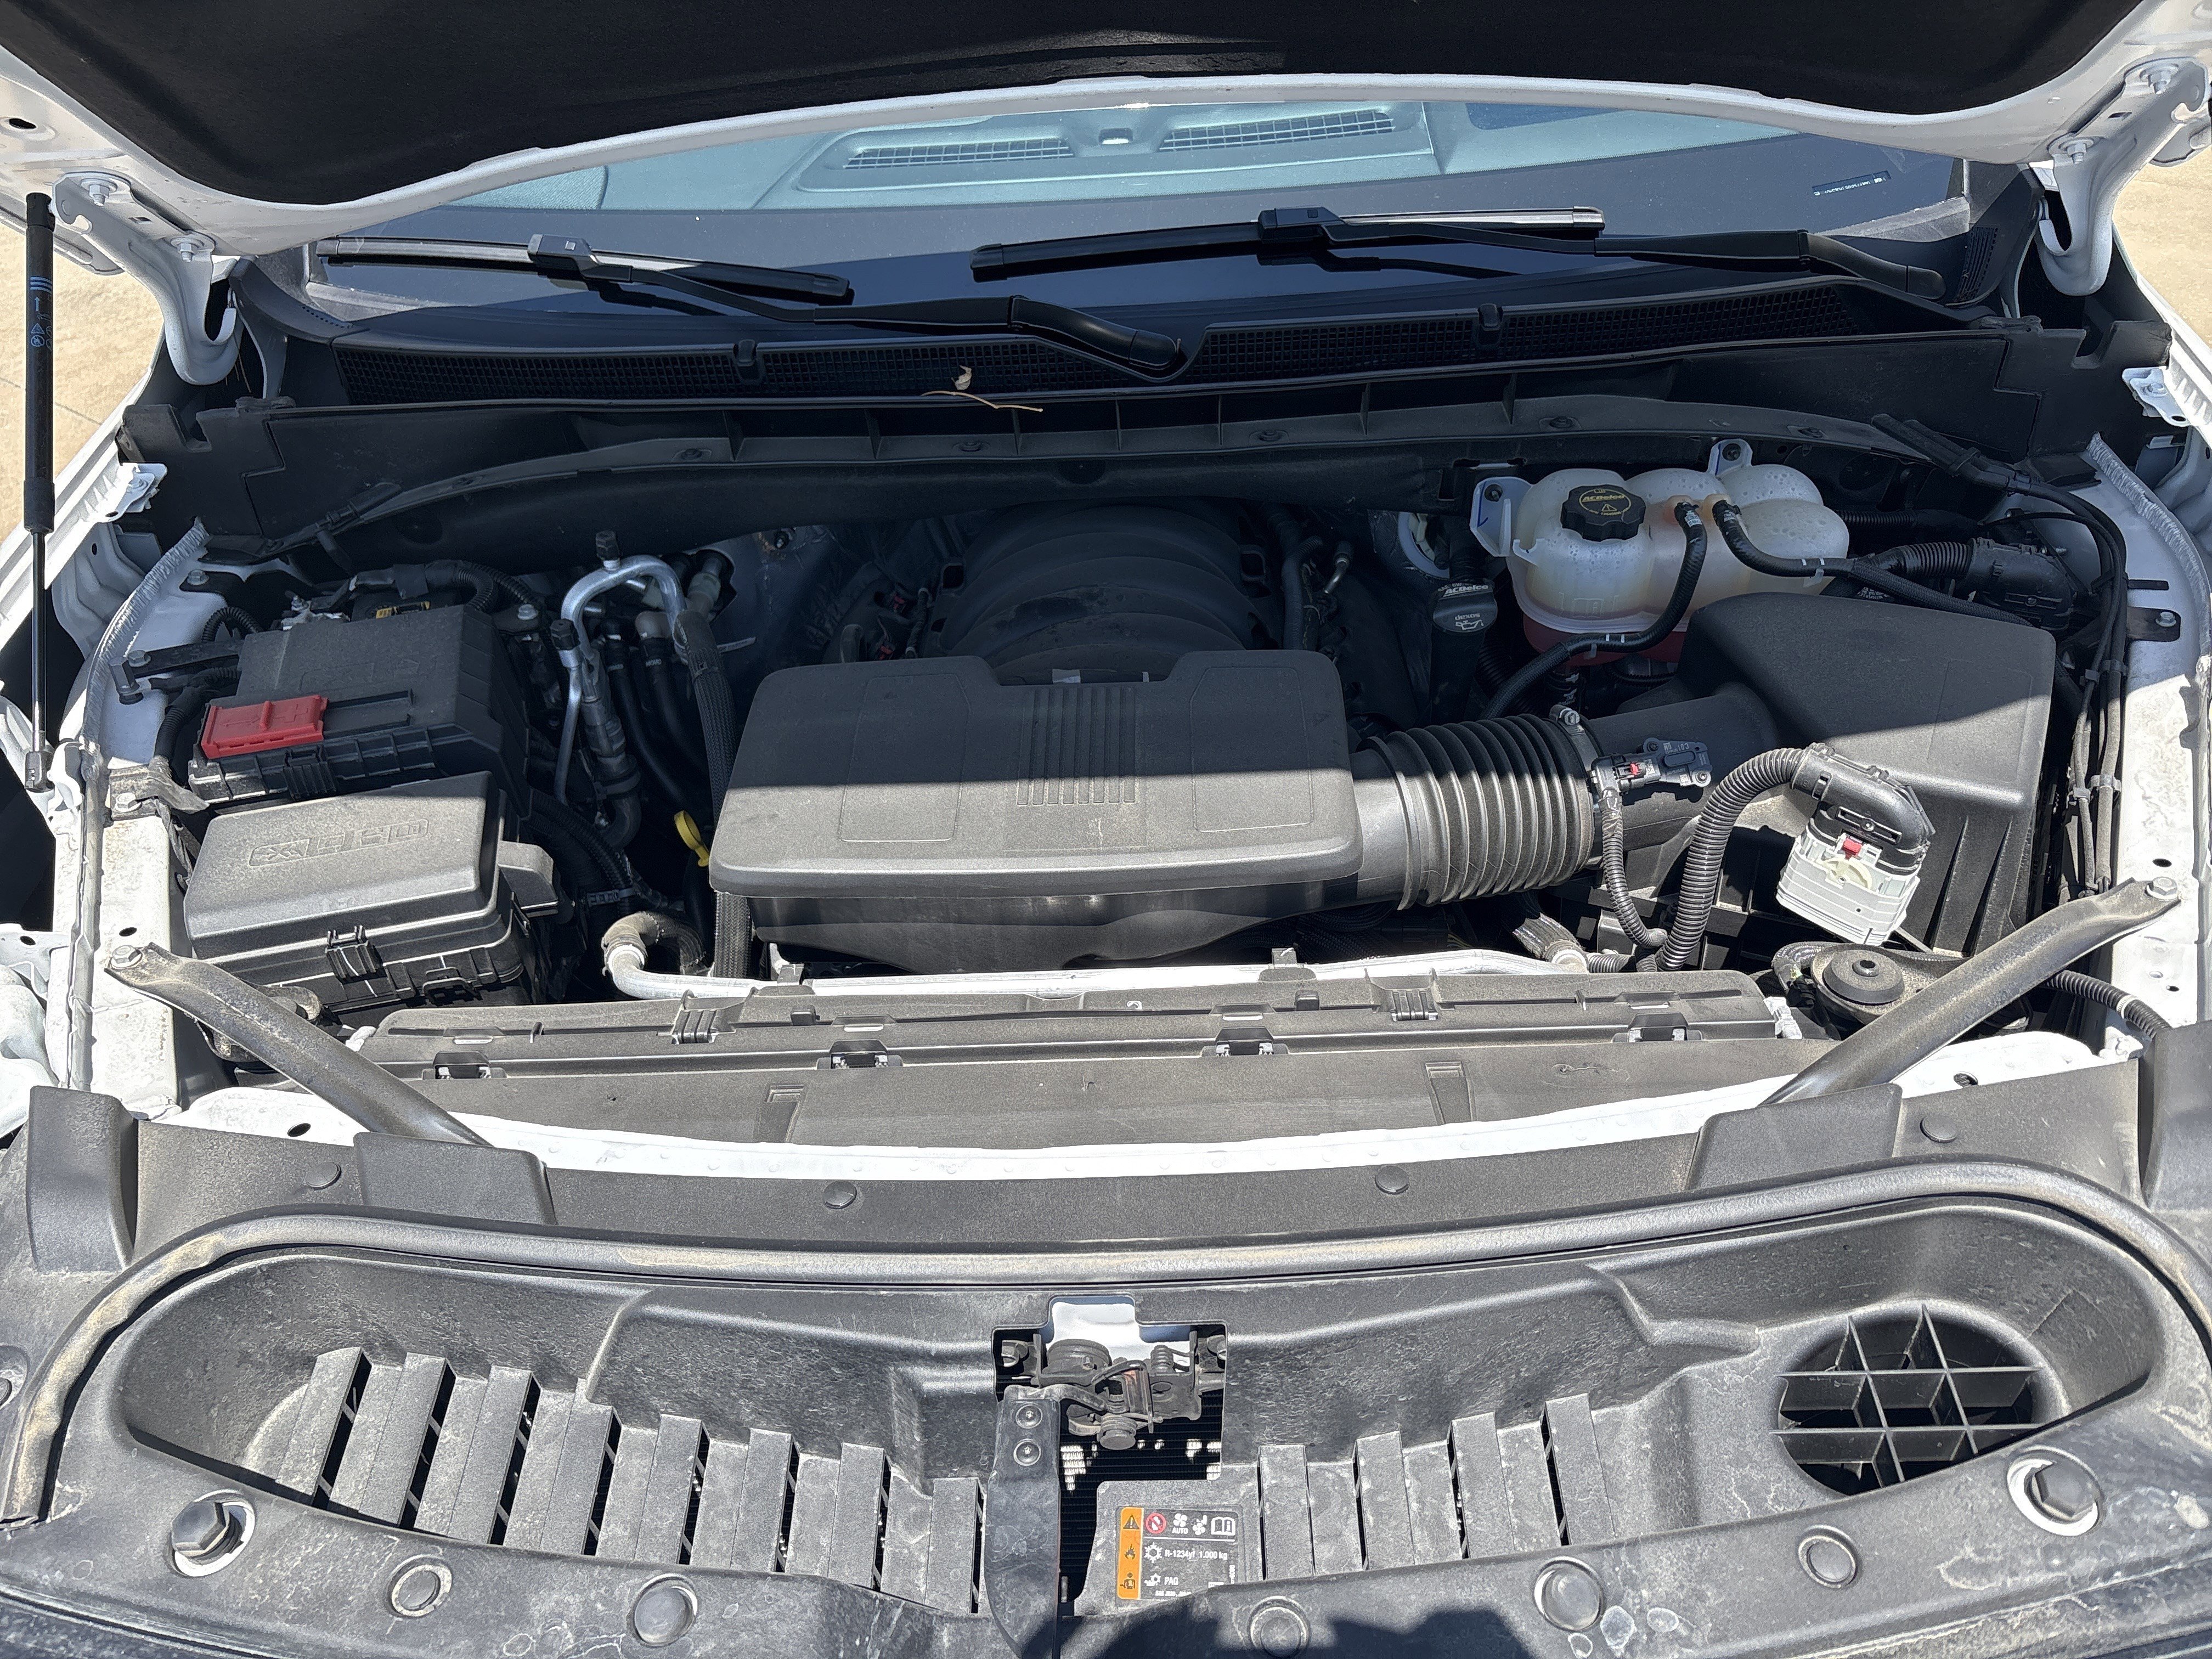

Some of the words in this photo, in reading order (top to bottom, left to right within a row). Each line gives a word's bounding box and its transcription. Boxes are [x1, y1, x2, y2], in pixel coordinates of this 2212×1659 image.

[1444, 585, 1488, 595] ACDelco
[1165, 1549, 1195, 1559] R-1234yf
[1218, 1551, 1228, 1560] kg
[1164, 1577, 1179, 1585] PAG
